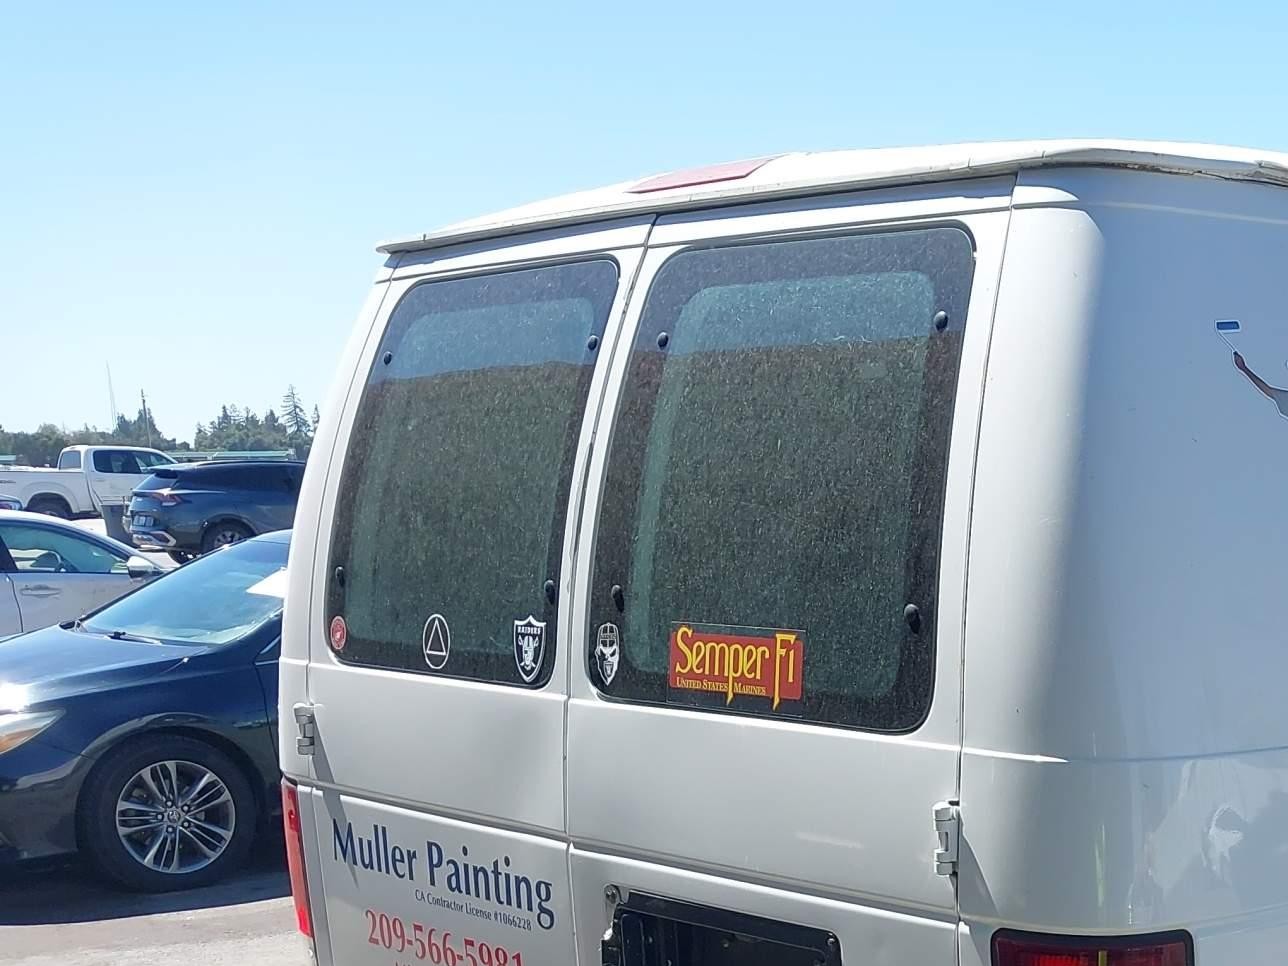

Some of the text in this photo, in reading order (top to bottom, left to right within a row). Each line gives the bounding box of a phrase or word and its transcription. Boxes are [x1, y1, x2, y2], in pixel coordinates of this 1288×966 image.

[517, 626, 541, 634] RAIDERS
[675, 626, 770, 706] Semper
[333, 818, 555, 930] Muller Painting
[415, 889, 426, 902] CA
[427, 892, 464, 913] Contractor
[465, 902, 492, 921] License
